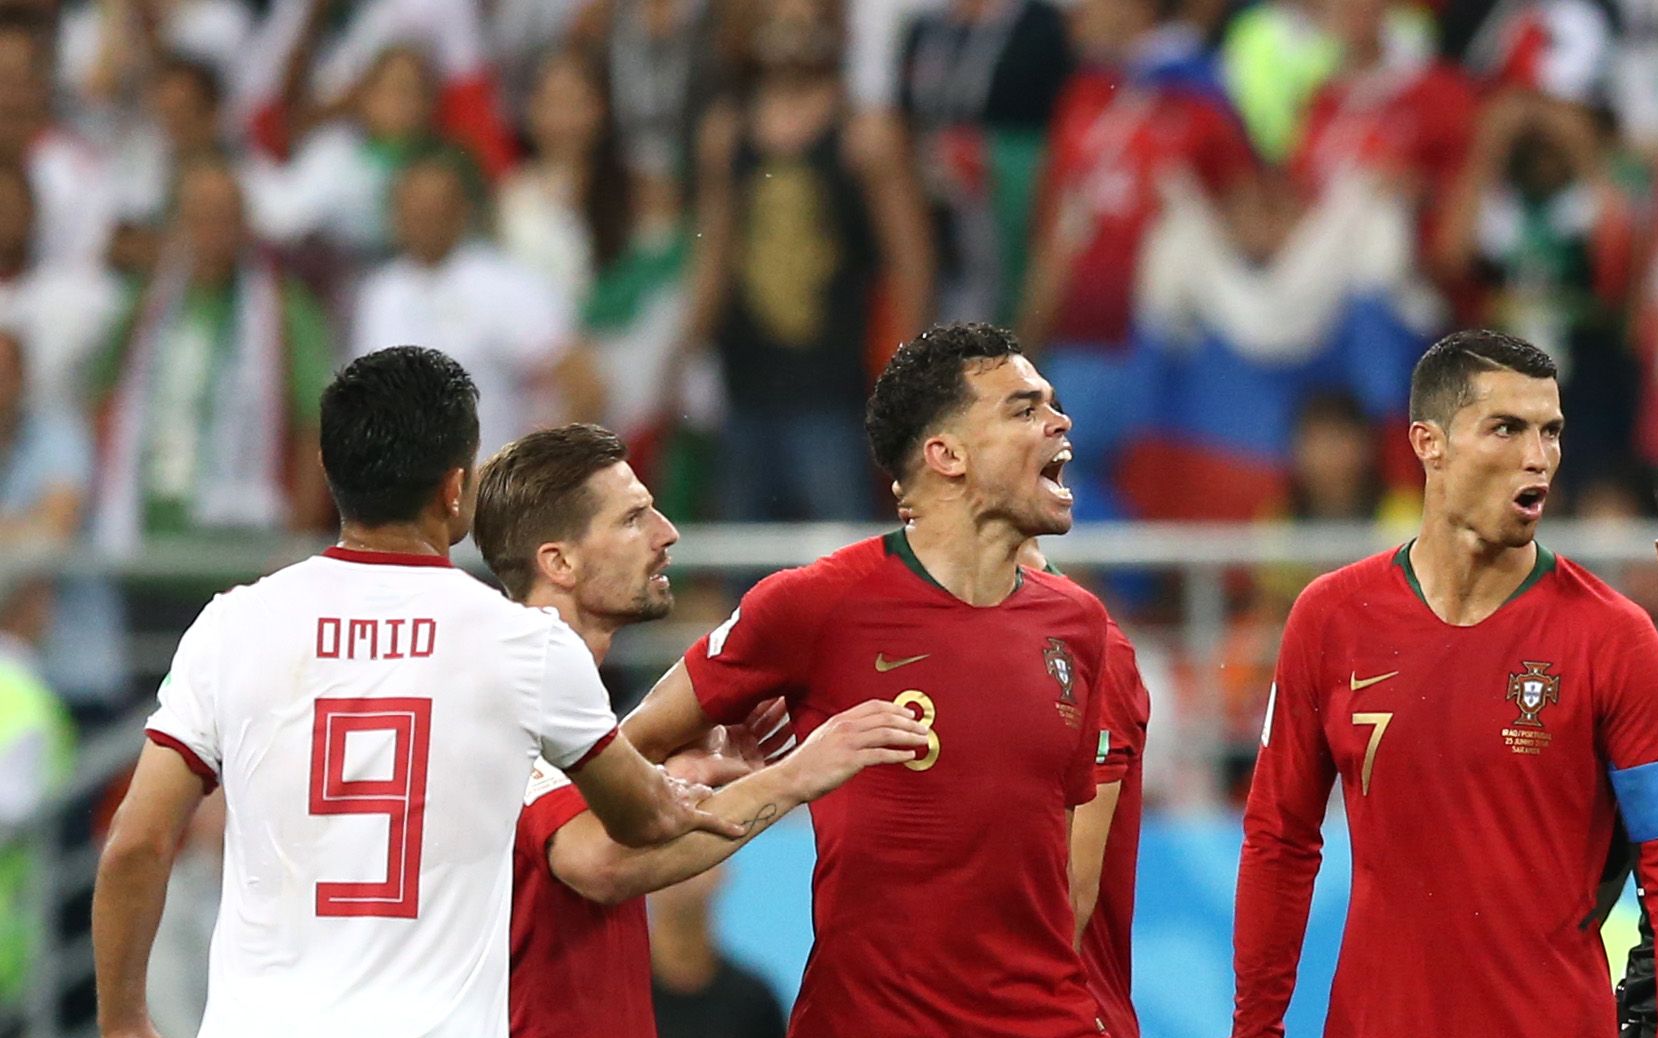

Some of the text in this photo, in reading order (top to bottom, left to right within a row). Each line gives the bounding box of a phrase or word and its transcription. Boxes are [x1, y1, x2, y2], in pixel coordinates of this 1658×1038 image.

[316, 617, 437, 660] OMID
[1351, 712, 1394, 796] 7
[308, 696, 433, 920] 9
